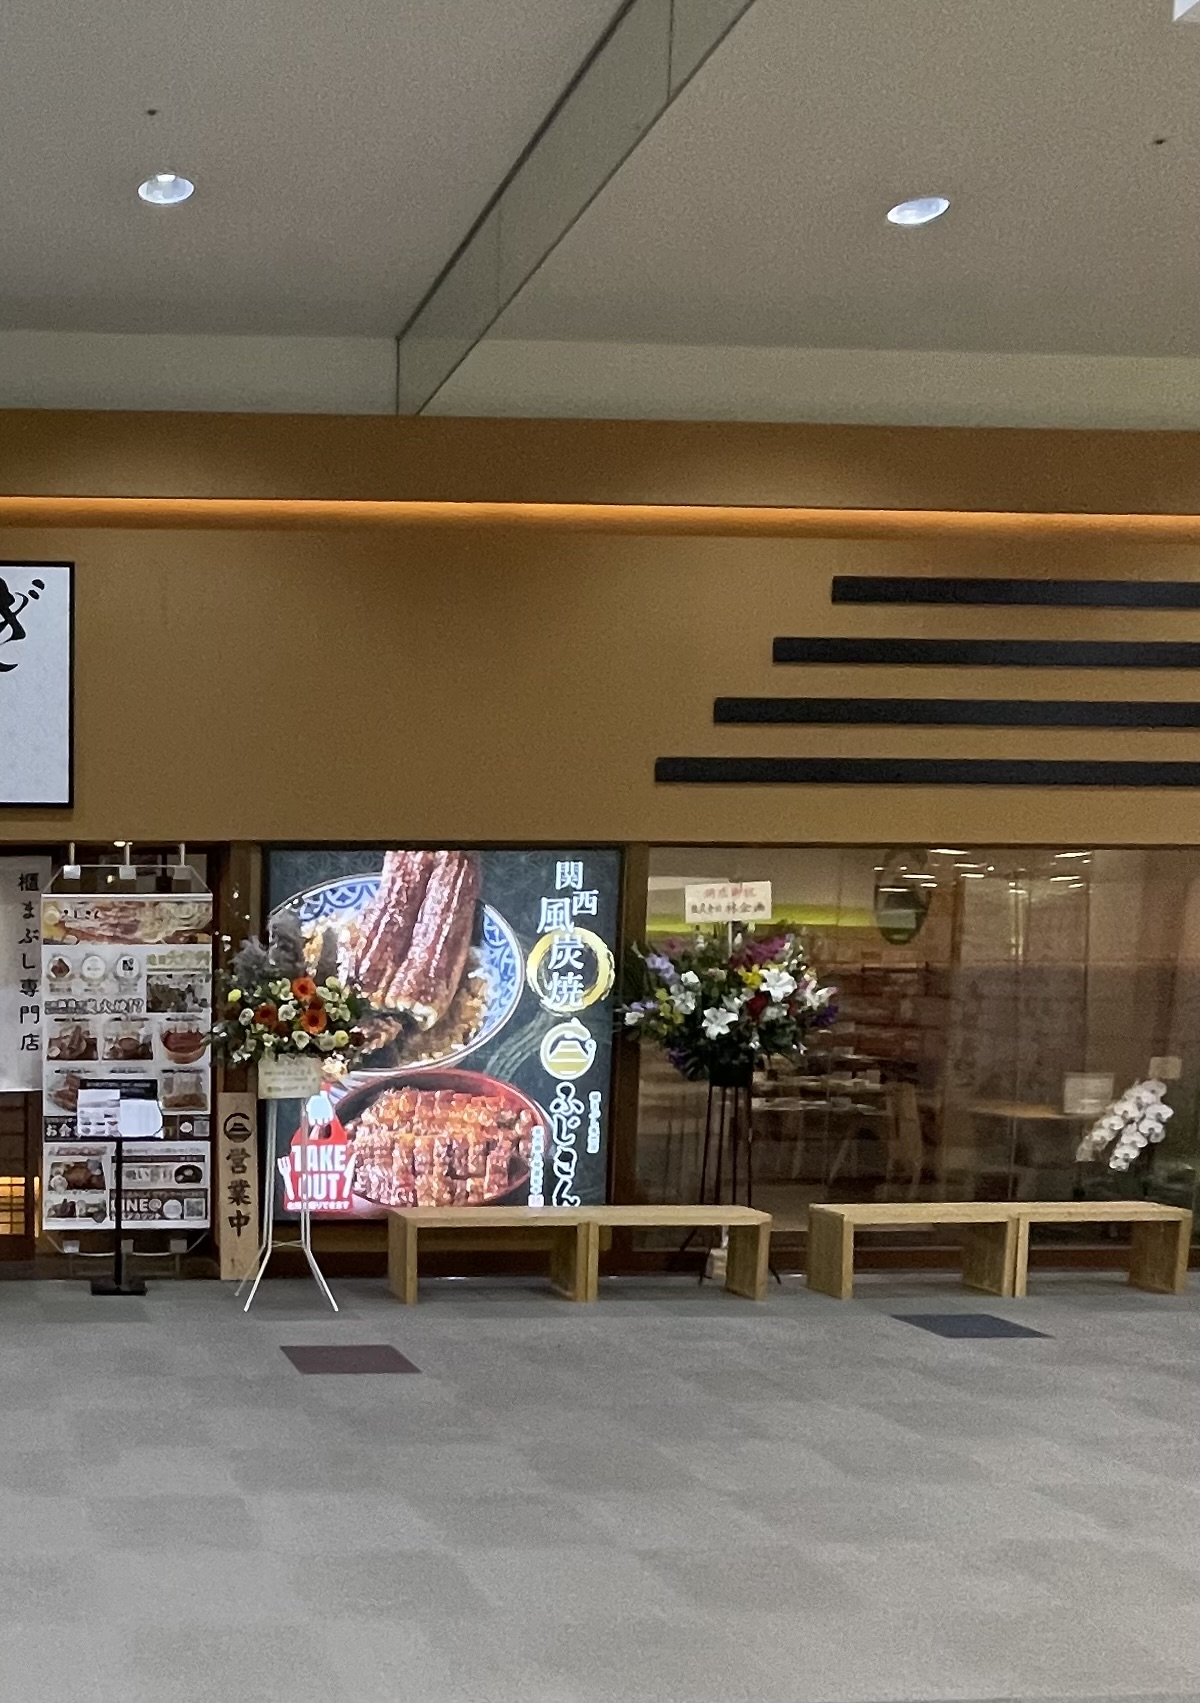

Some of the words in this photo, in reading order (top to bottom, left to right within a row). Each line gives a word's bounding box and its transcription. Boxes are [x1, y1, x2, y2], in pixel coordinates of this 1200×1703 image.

[18, 872, 41, 1052] 櫃まぶし専門店
[226, 1148, 252, 1238] 営業中
[291, 1144, 347, 1172] TAKE
